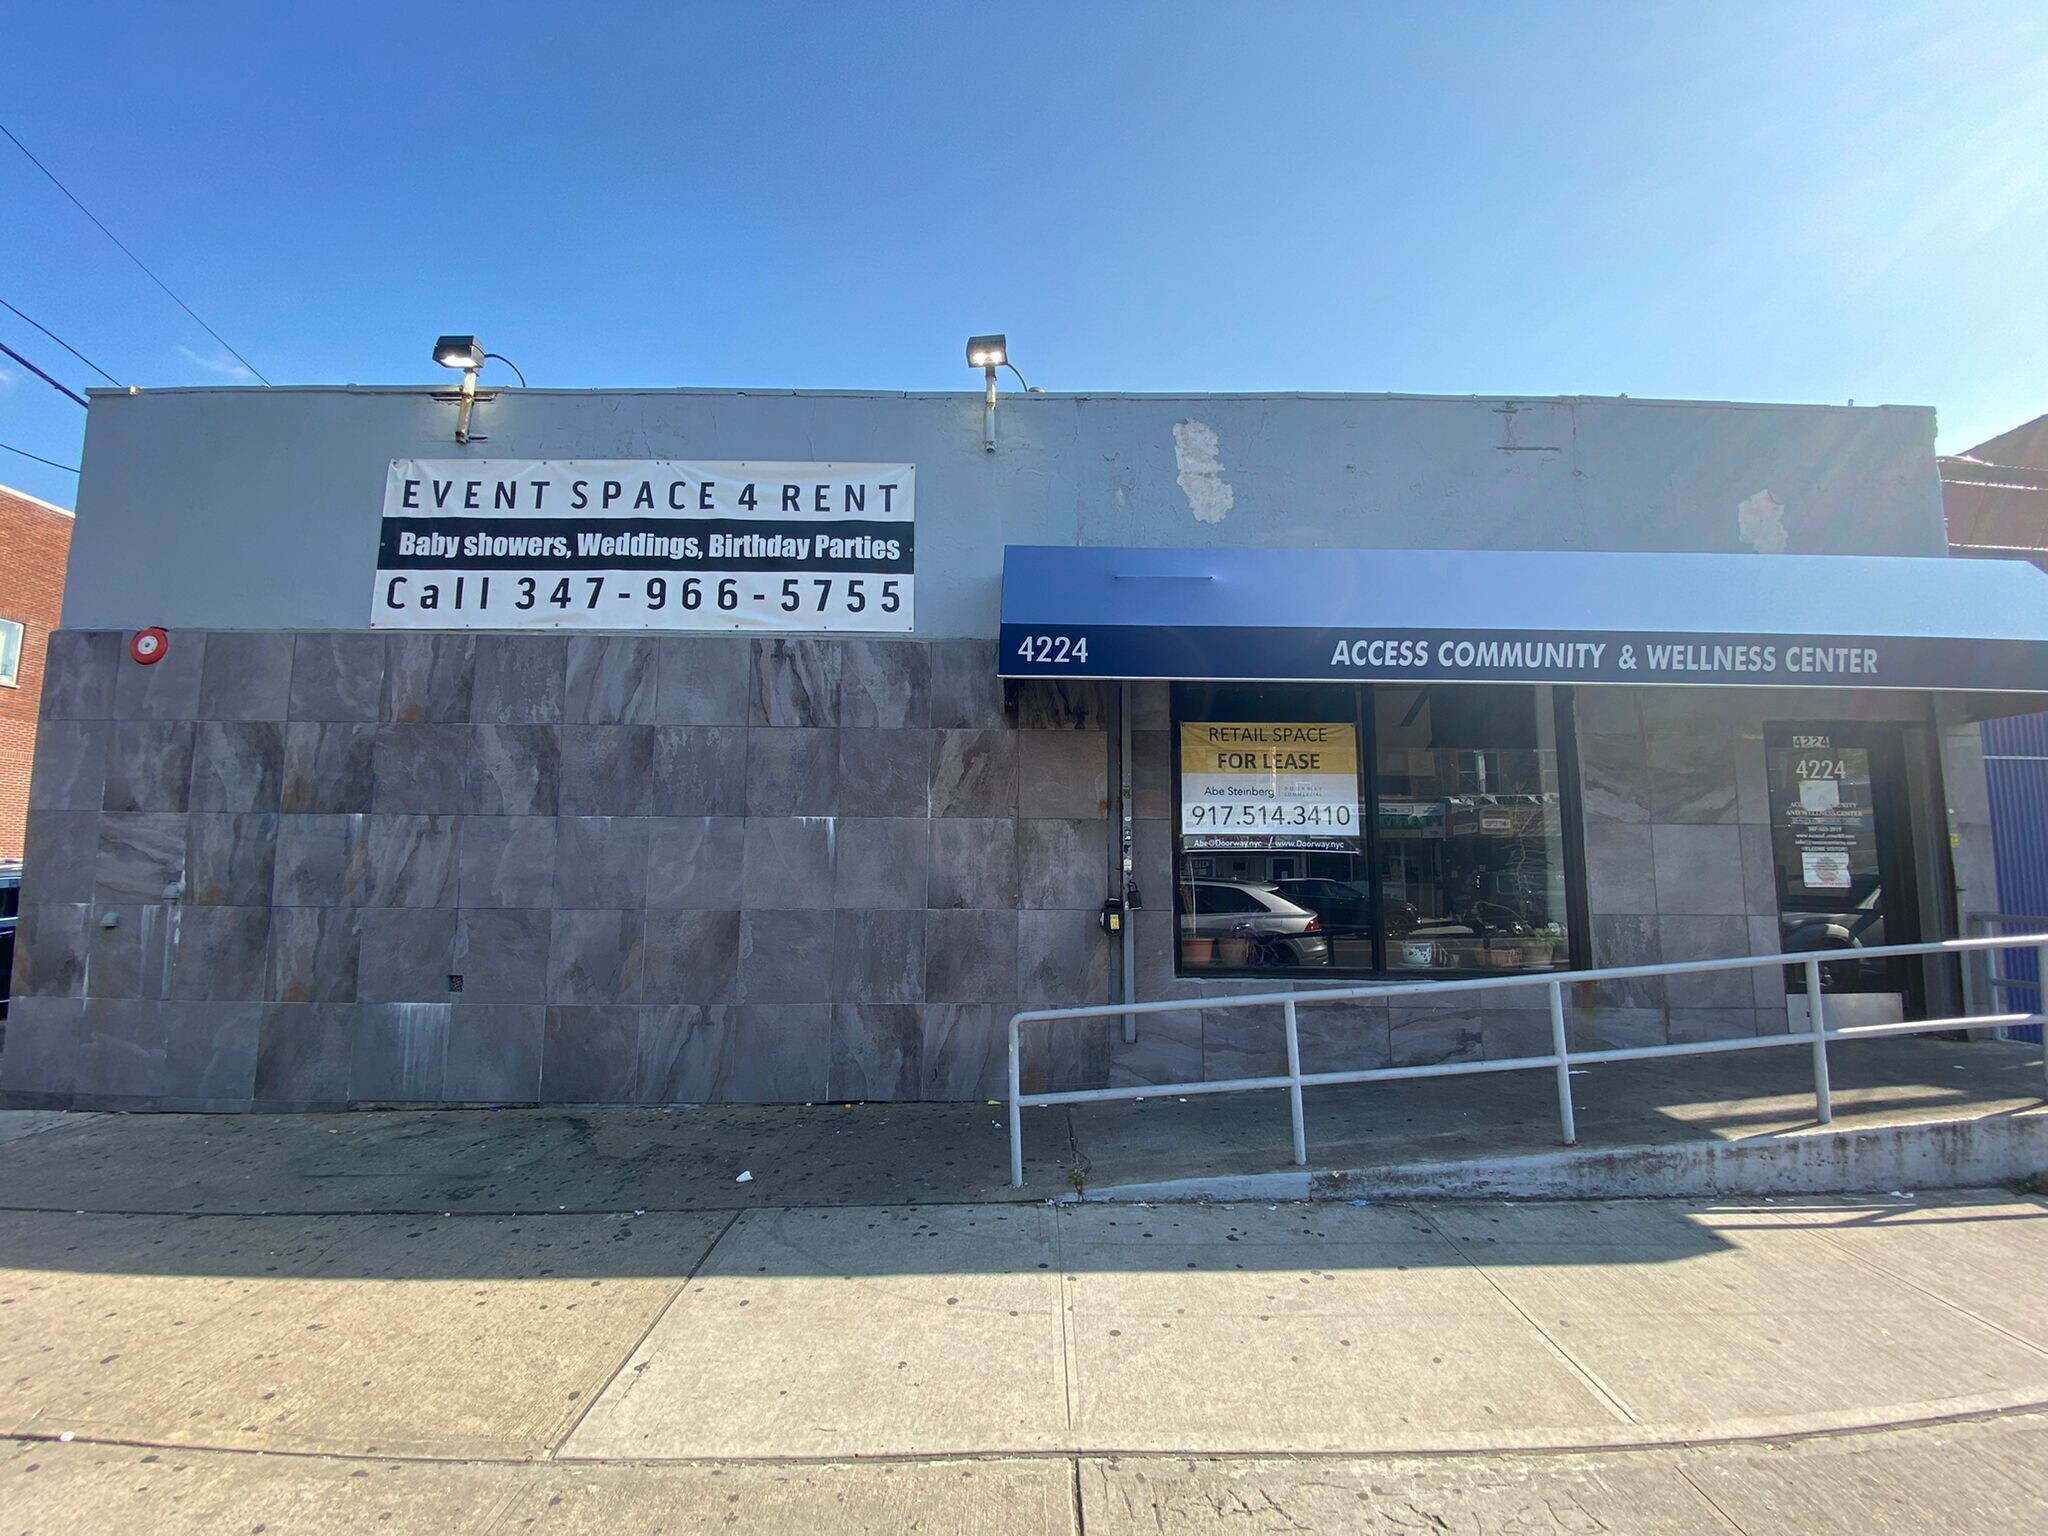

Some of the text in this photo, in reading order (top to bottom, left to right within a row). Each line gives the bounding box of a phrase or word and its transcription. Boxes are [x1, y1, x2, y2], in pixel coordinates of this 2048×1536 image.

[402, 480, 898, 513] EVENT SPACE 4 RENT
[398, 531, 901, 560] Baby showers, Weddings, Birthday Parties
[386, 576, 900, 613] Call 347-966-5755
[1018, 636, 1089, 663] 4224
[1330, 640, 1878, 673] ACCESS COMMUNITY & WELLNESS CENTER
[1208, 727, 1329, 743] RETAIL SPACE
[1794, 736, 1828, 748] 4224
[1218, 752, 1321, 770] FOR LEASE
[1795, 759, 1847, 779] 4224
[1204, 786, 1275, 799] Abe Steinberg
[1191, 805, 1351, 826] 917.514.3410
[1275, 839, 1345, 849] www.Doorway.nyc
